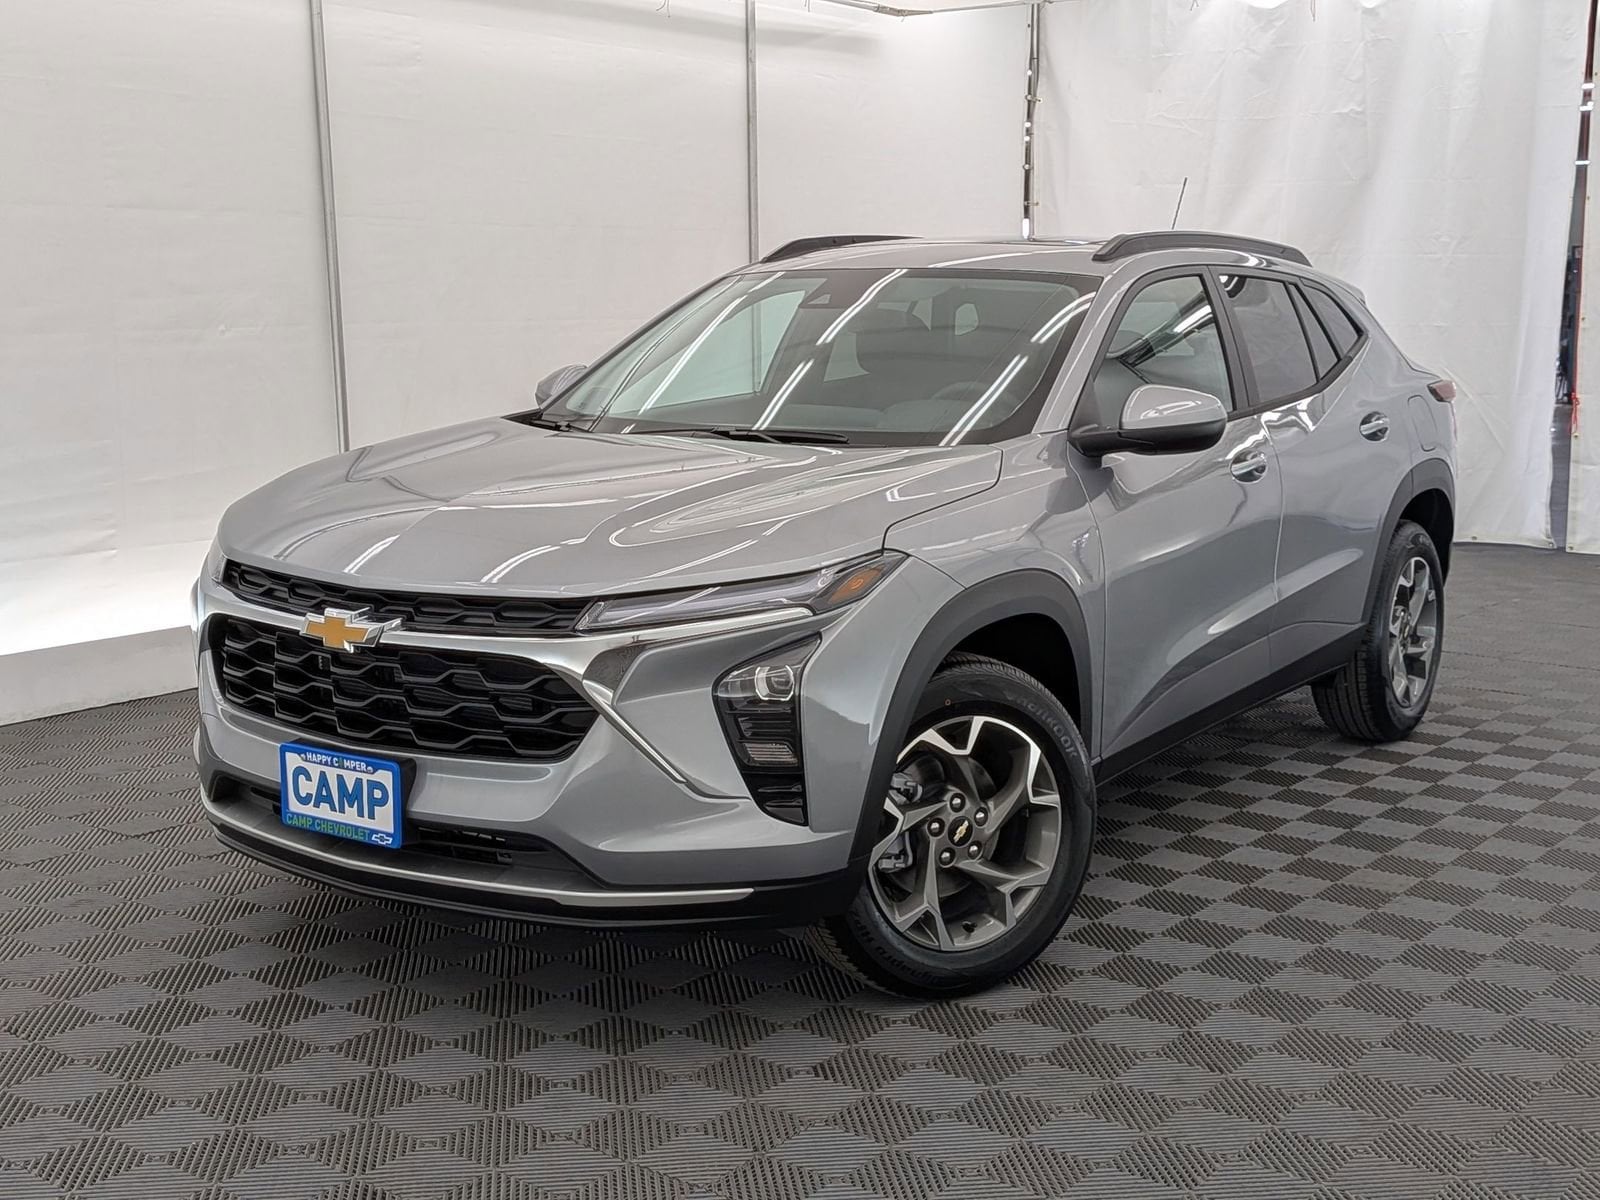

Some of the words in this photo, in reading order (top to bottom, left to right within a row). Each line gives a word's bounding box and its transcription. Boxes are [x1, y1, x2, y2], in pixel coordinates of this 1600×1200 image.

[306, 752, 331, 765] HAPPY
[292, 765, 389, 820] CAMP
[287, 814, 313, 829] CAMP
[315, 821, 370, 841] CHEVROLET
